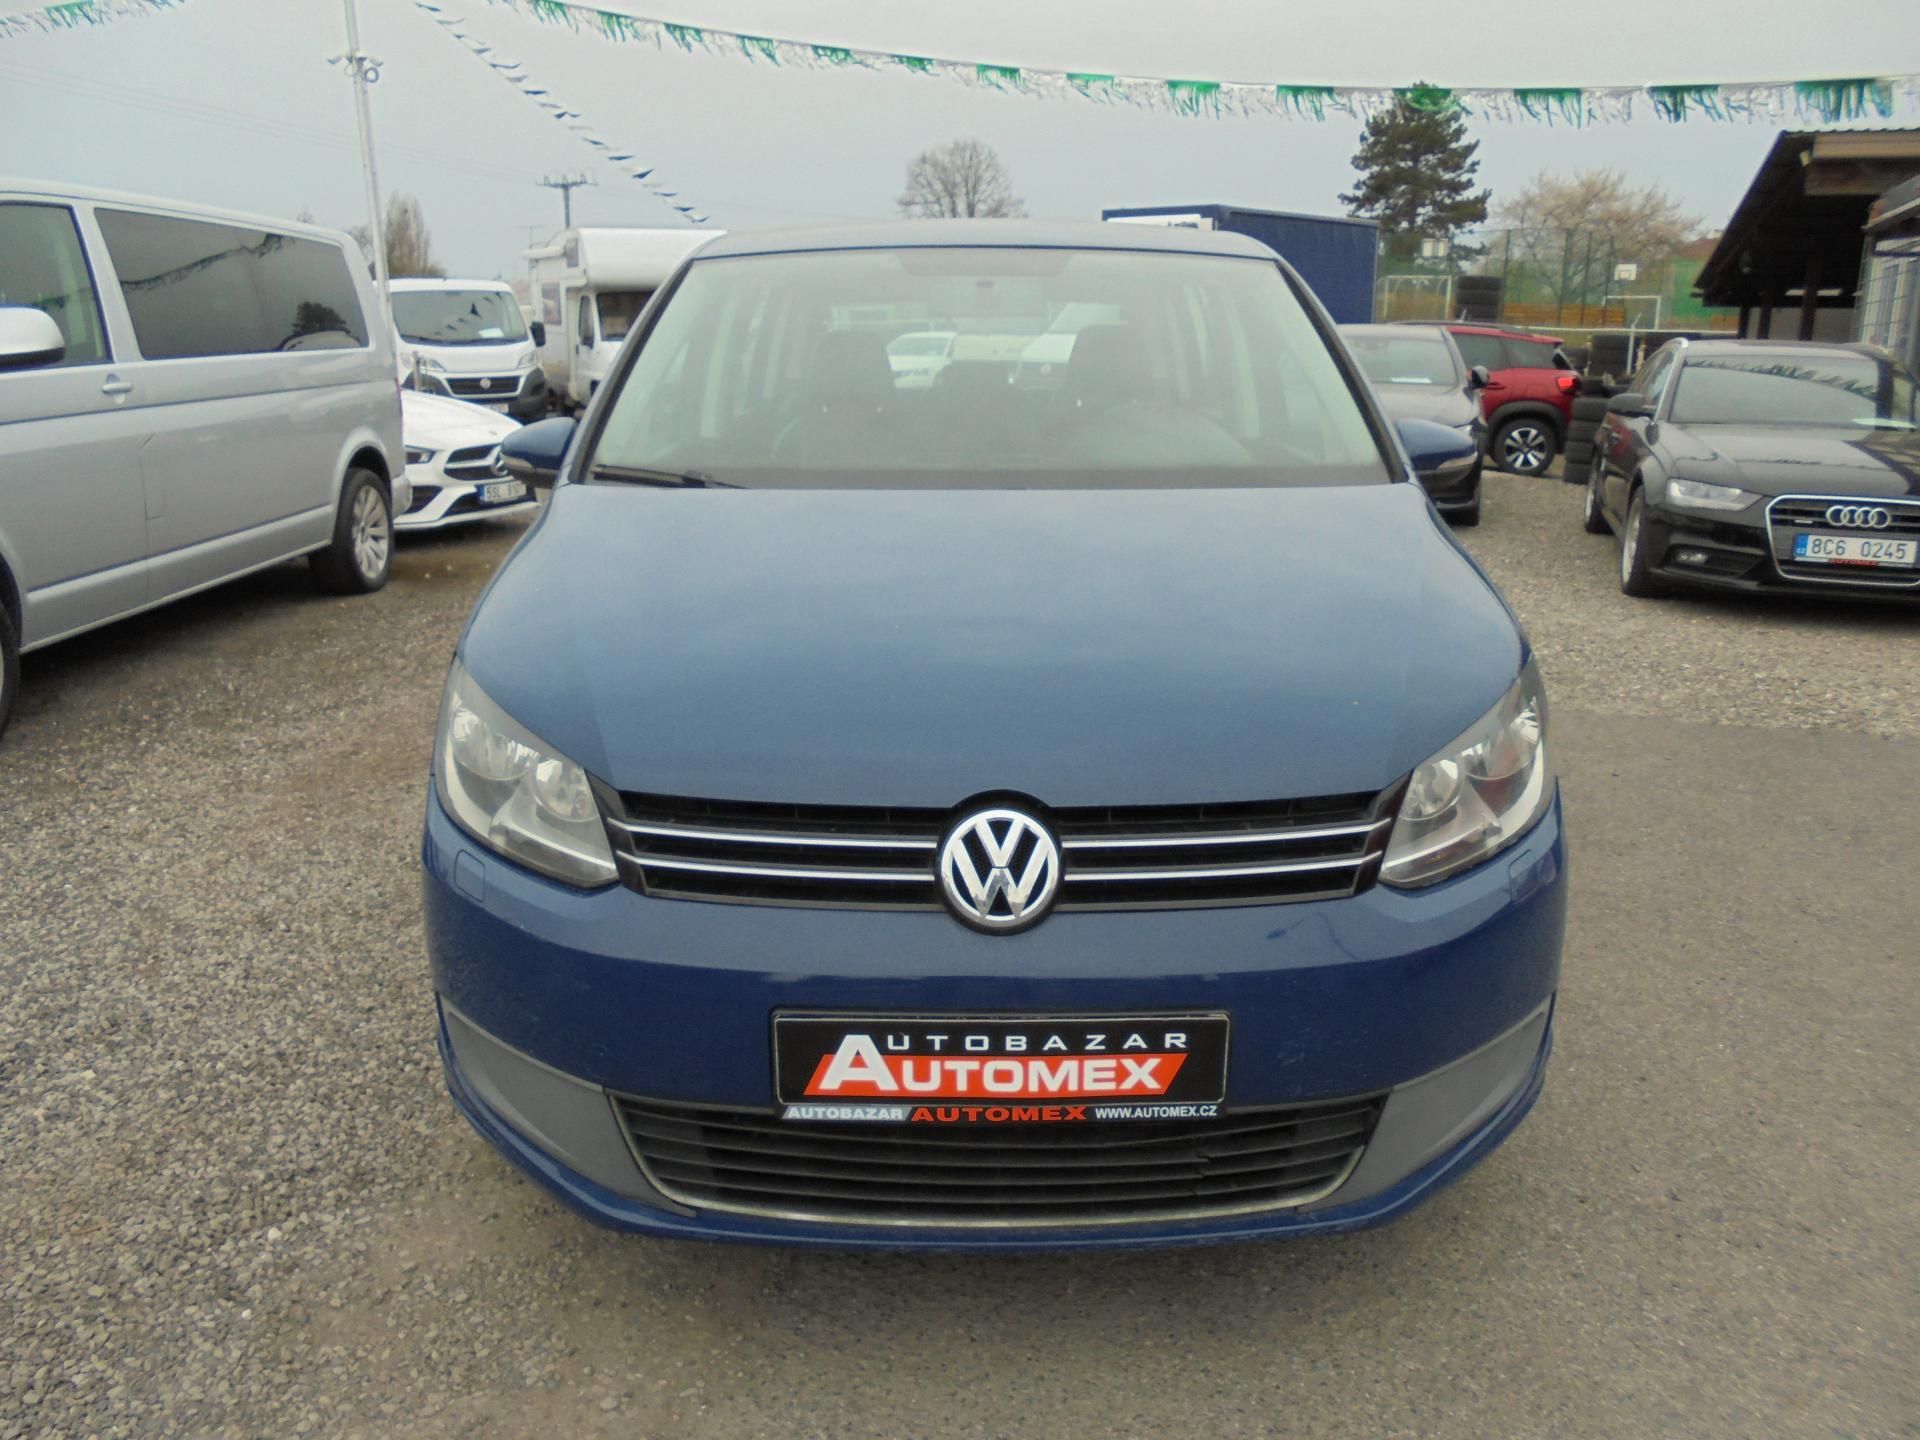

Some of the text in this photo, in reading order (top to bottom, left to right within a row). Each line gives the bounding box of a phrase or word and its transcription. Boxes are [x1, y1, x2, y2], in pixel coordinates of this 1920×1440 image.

[1811, 538, 1907, 559] 8C6 0245
[818, 1034, 1162, 1092] AUTOMEX
[787, 1105, 1218, 1122] AUTOBAZAR AUTOMEX WWW.AUTOMEX.CZ
